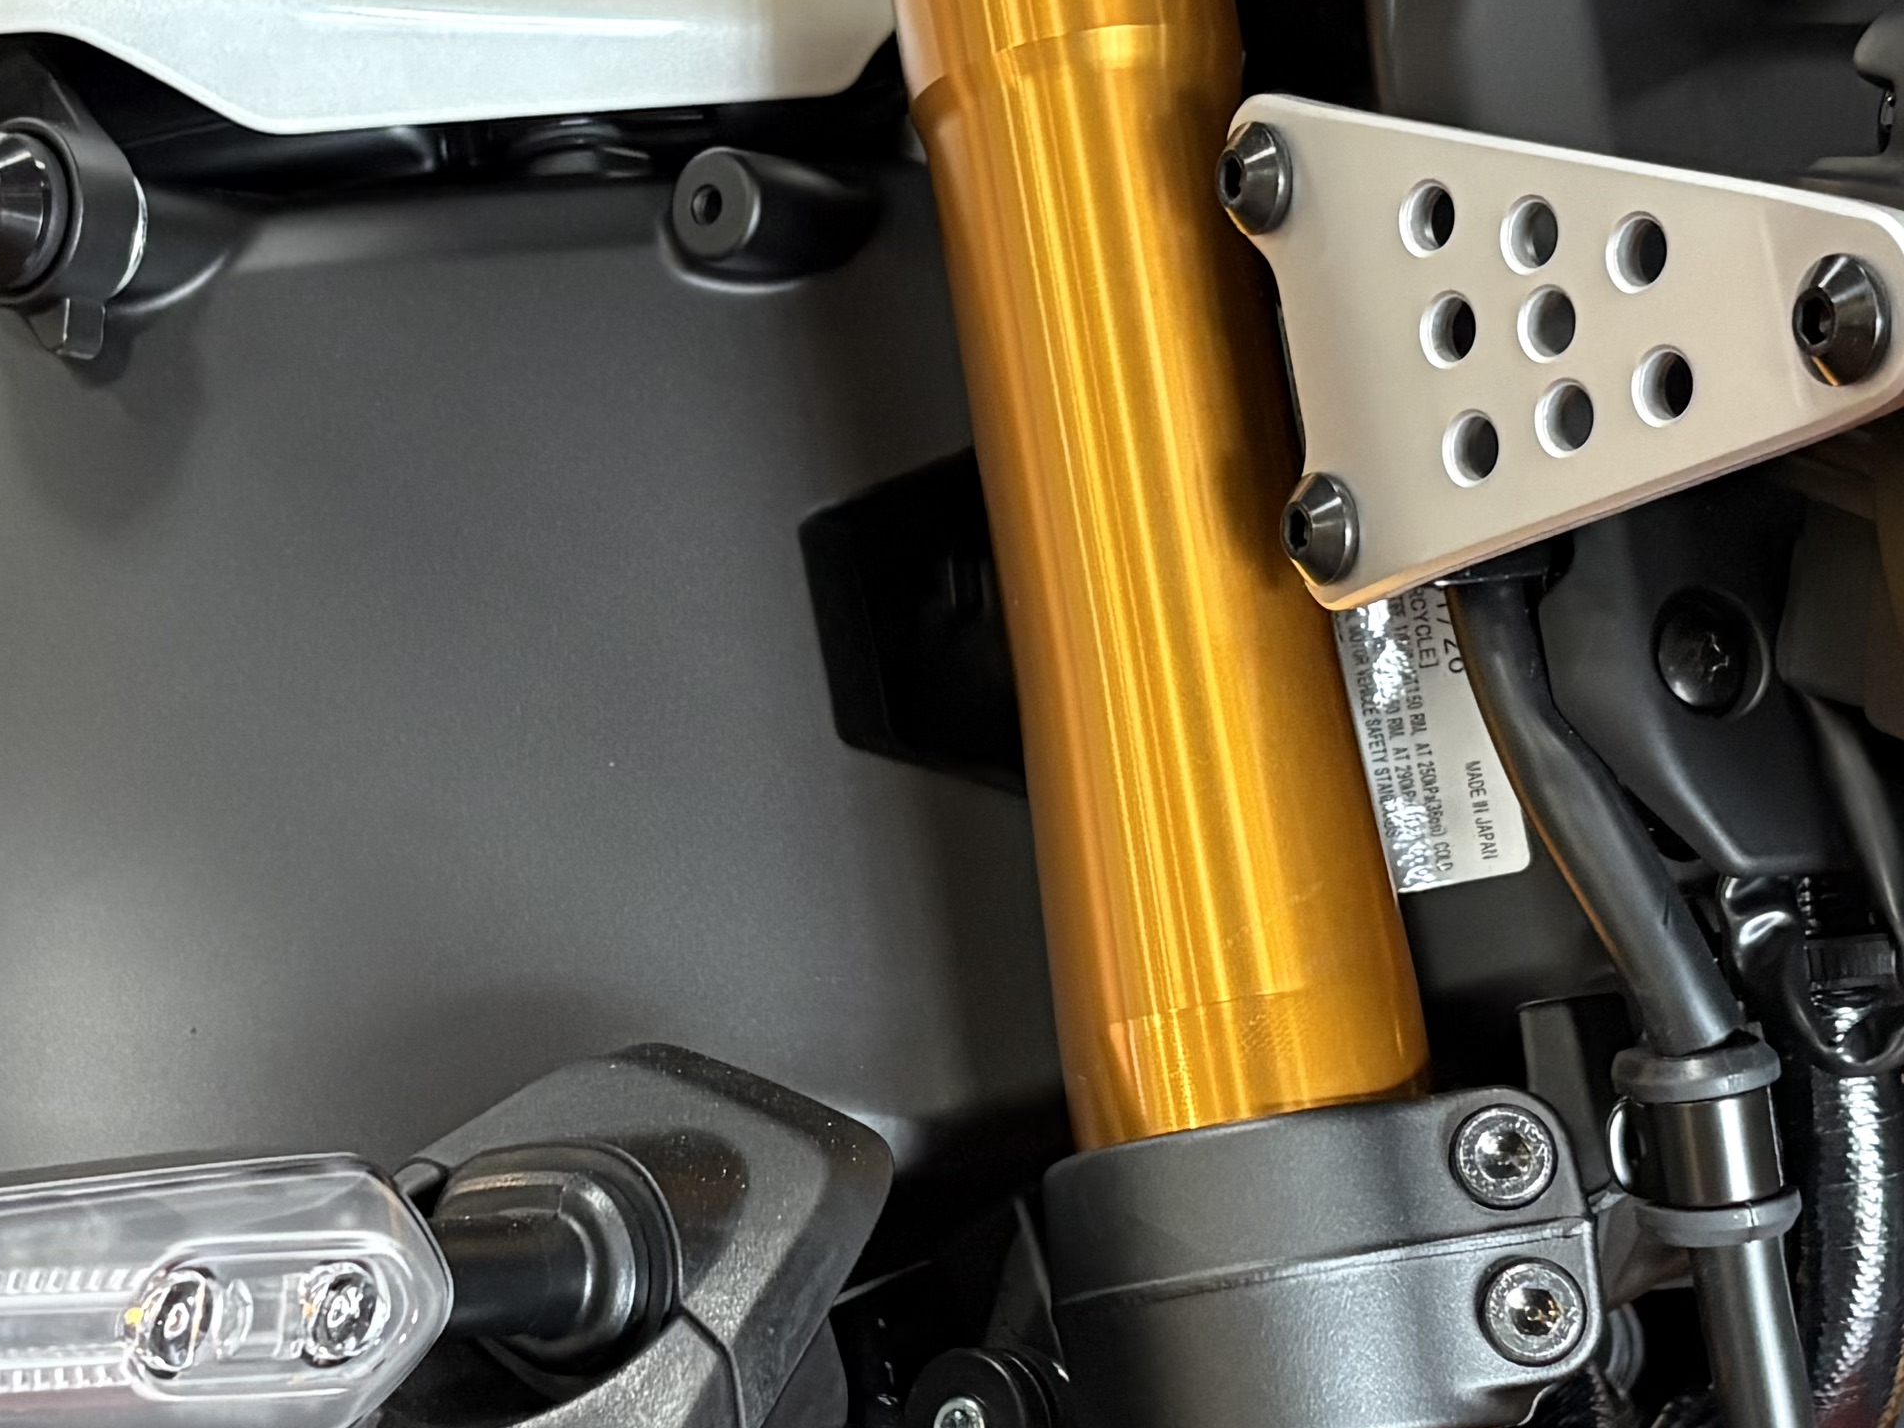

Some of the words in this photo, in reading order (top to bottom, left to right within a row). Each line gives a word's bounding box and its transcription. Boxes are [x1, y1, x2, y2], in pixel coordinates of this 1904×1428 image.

[1365, 719, 1388, 763] SAFETY
[1465, 760, 1487, 798] MADE
[1472, 800, 1489, 814] IN
[1475, 818, 1498, 860] JAPAN
